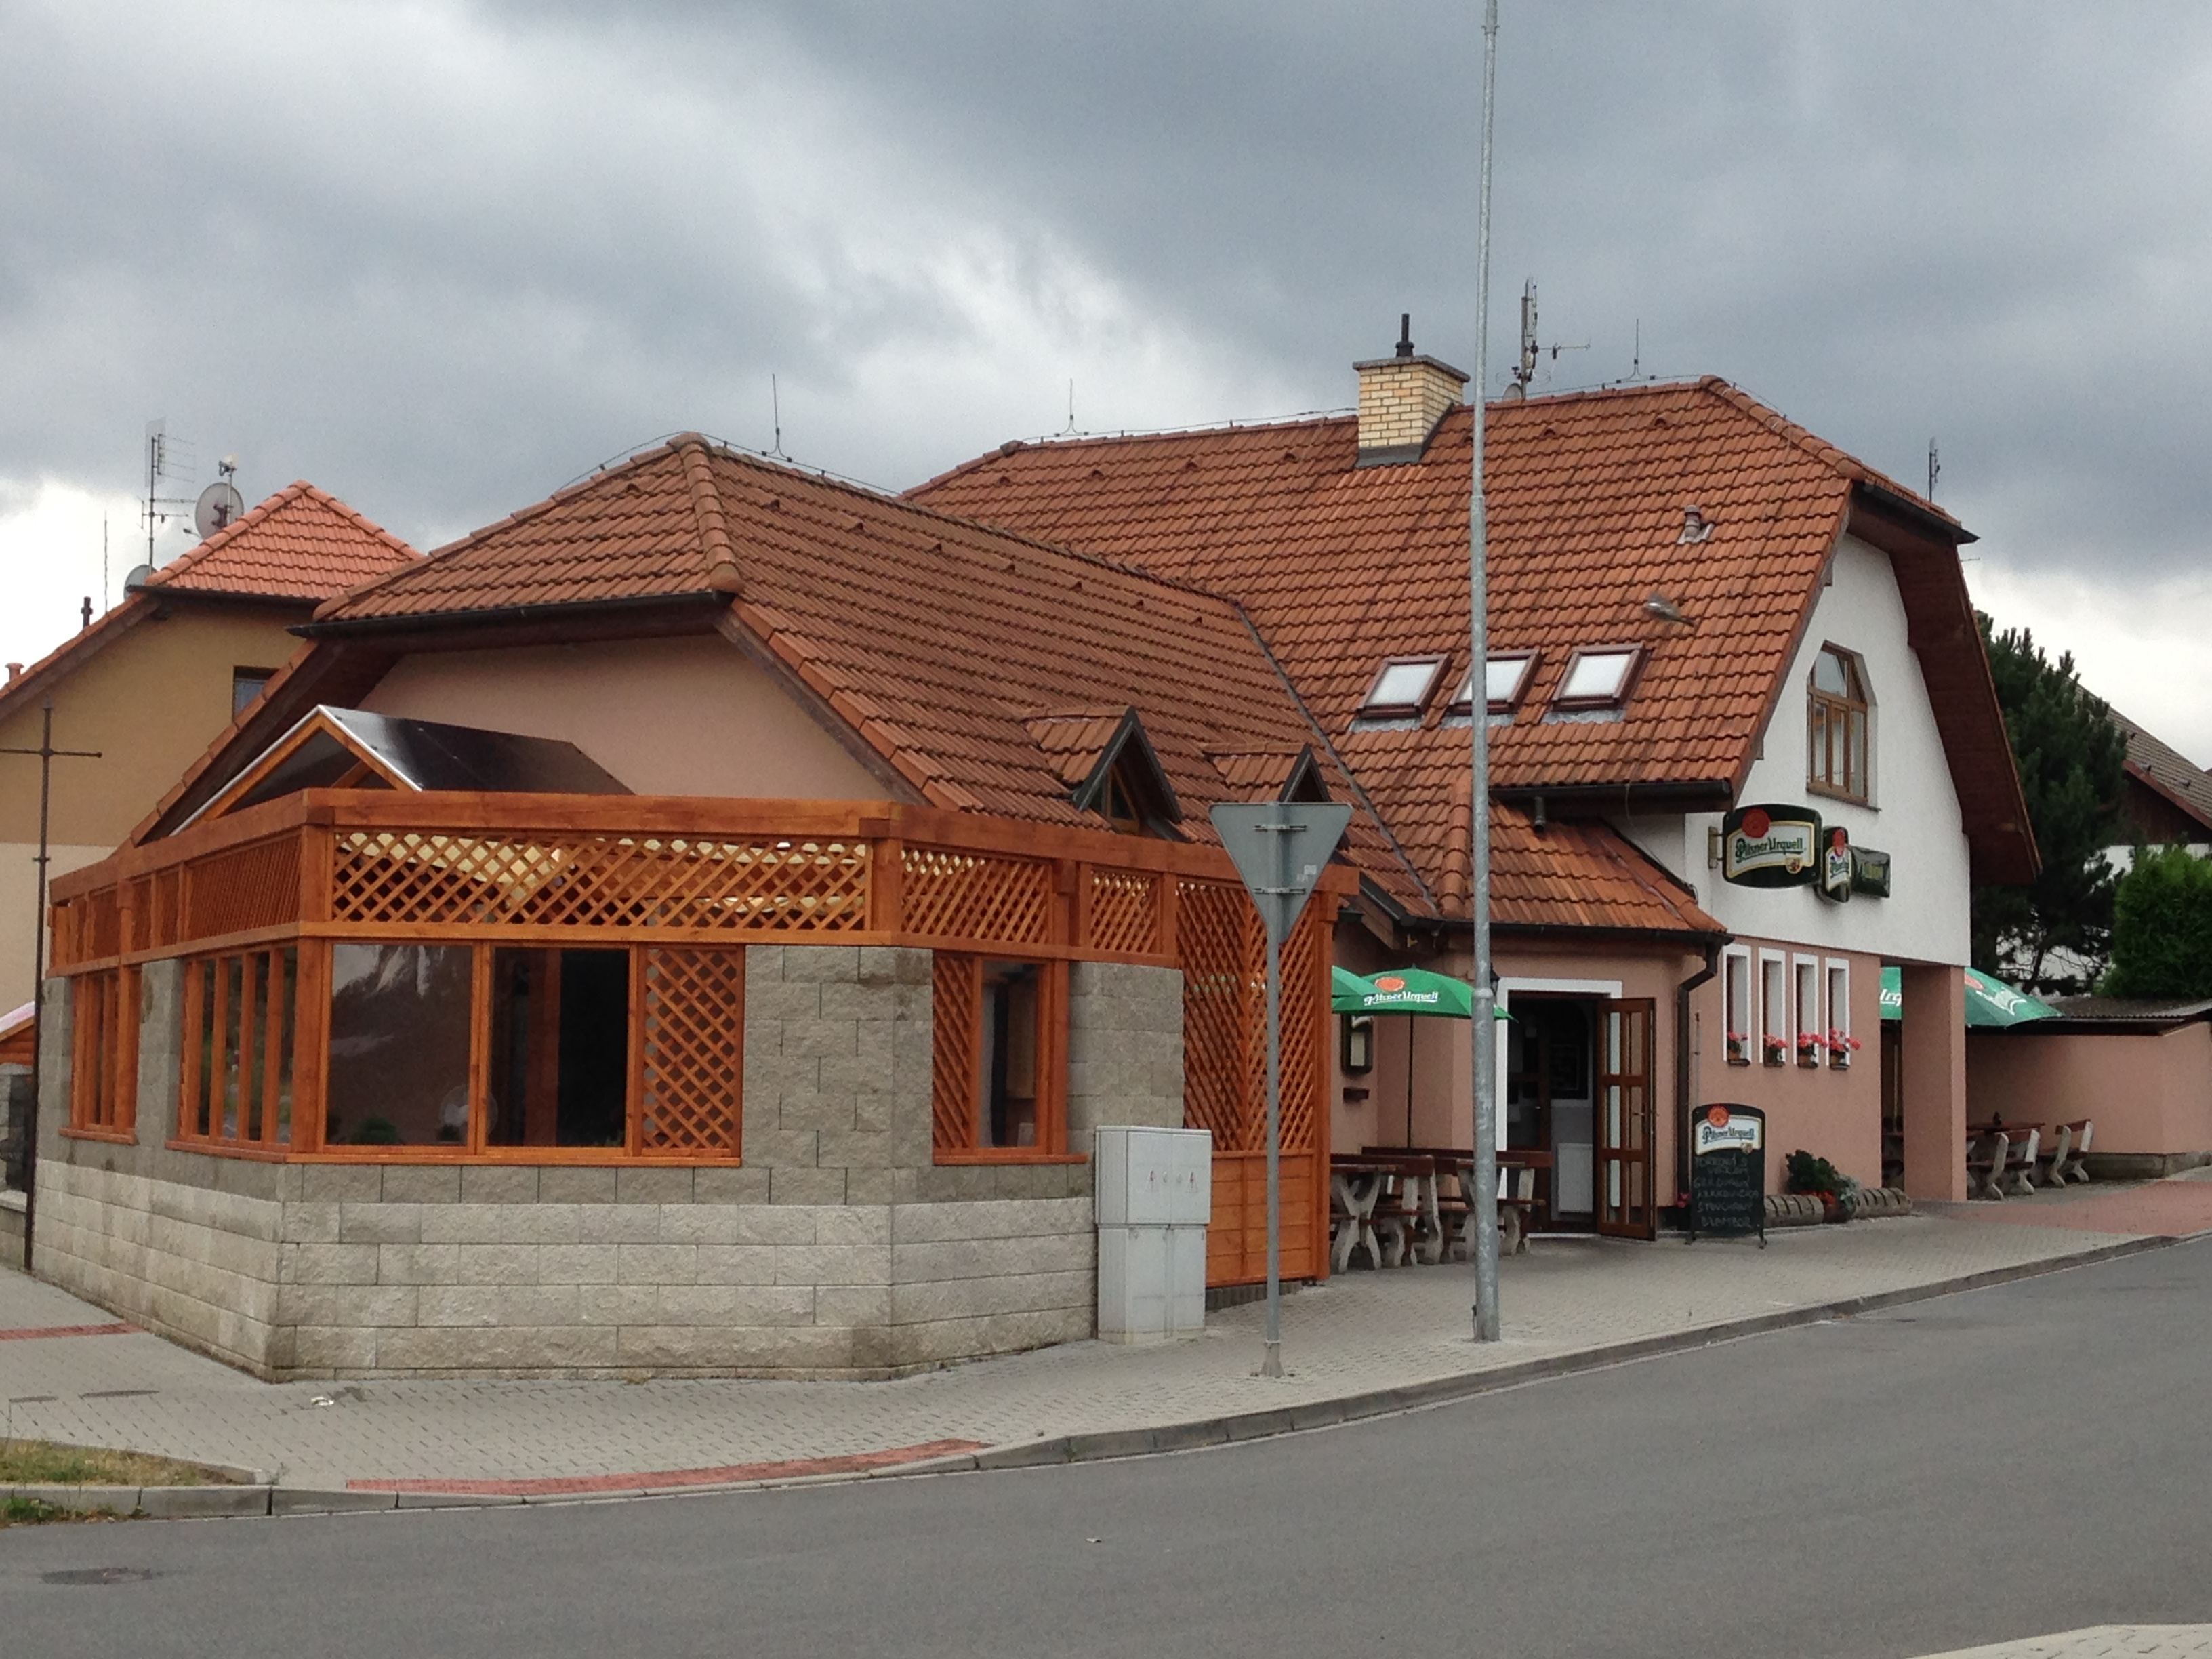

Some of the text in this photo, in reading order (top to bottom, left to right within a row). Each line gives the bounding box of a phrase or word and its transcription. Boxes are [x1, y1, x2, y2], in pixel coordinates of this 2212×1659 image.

[1736, 836, 1803, 863] Pilsner Urquell
[1402, 991, 1438, 1003] Urquell
[1702, 1126, 1754, 1145] Pilsner Urquell
